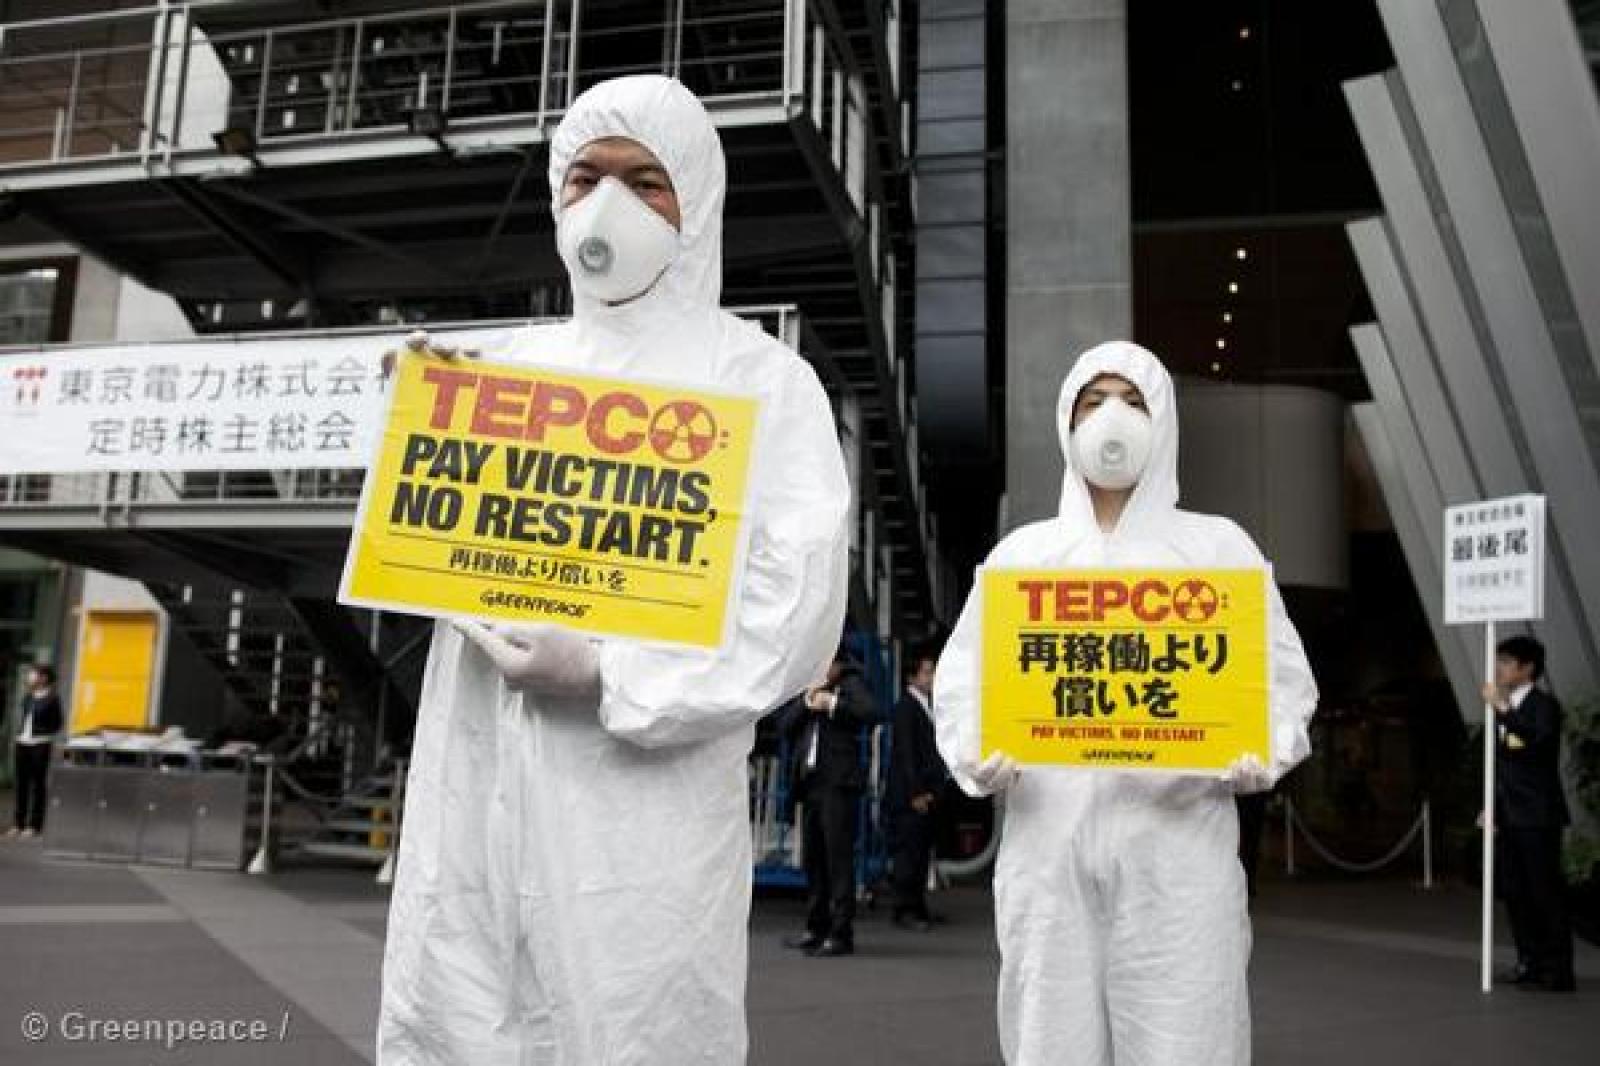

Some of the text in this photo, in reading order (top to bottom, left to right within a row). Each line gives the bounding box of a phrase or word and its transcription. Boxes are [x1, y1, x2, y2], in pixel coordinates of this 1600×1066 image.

[86, 410, 356, 456] 定時株主総会
[401, 433, 718, 522] PAY VICTIMS,
[390, 481, 710, 568] NO RESTART.
[479, 589, 593, 619] GREENPEACE
[1018, 632, 1229, 675] 再稼働より
[1052, 676, 1180, 718] 償いを
[1031, 725, 1057, 740] PAY
[1119, 727, 1141, 741] NO
